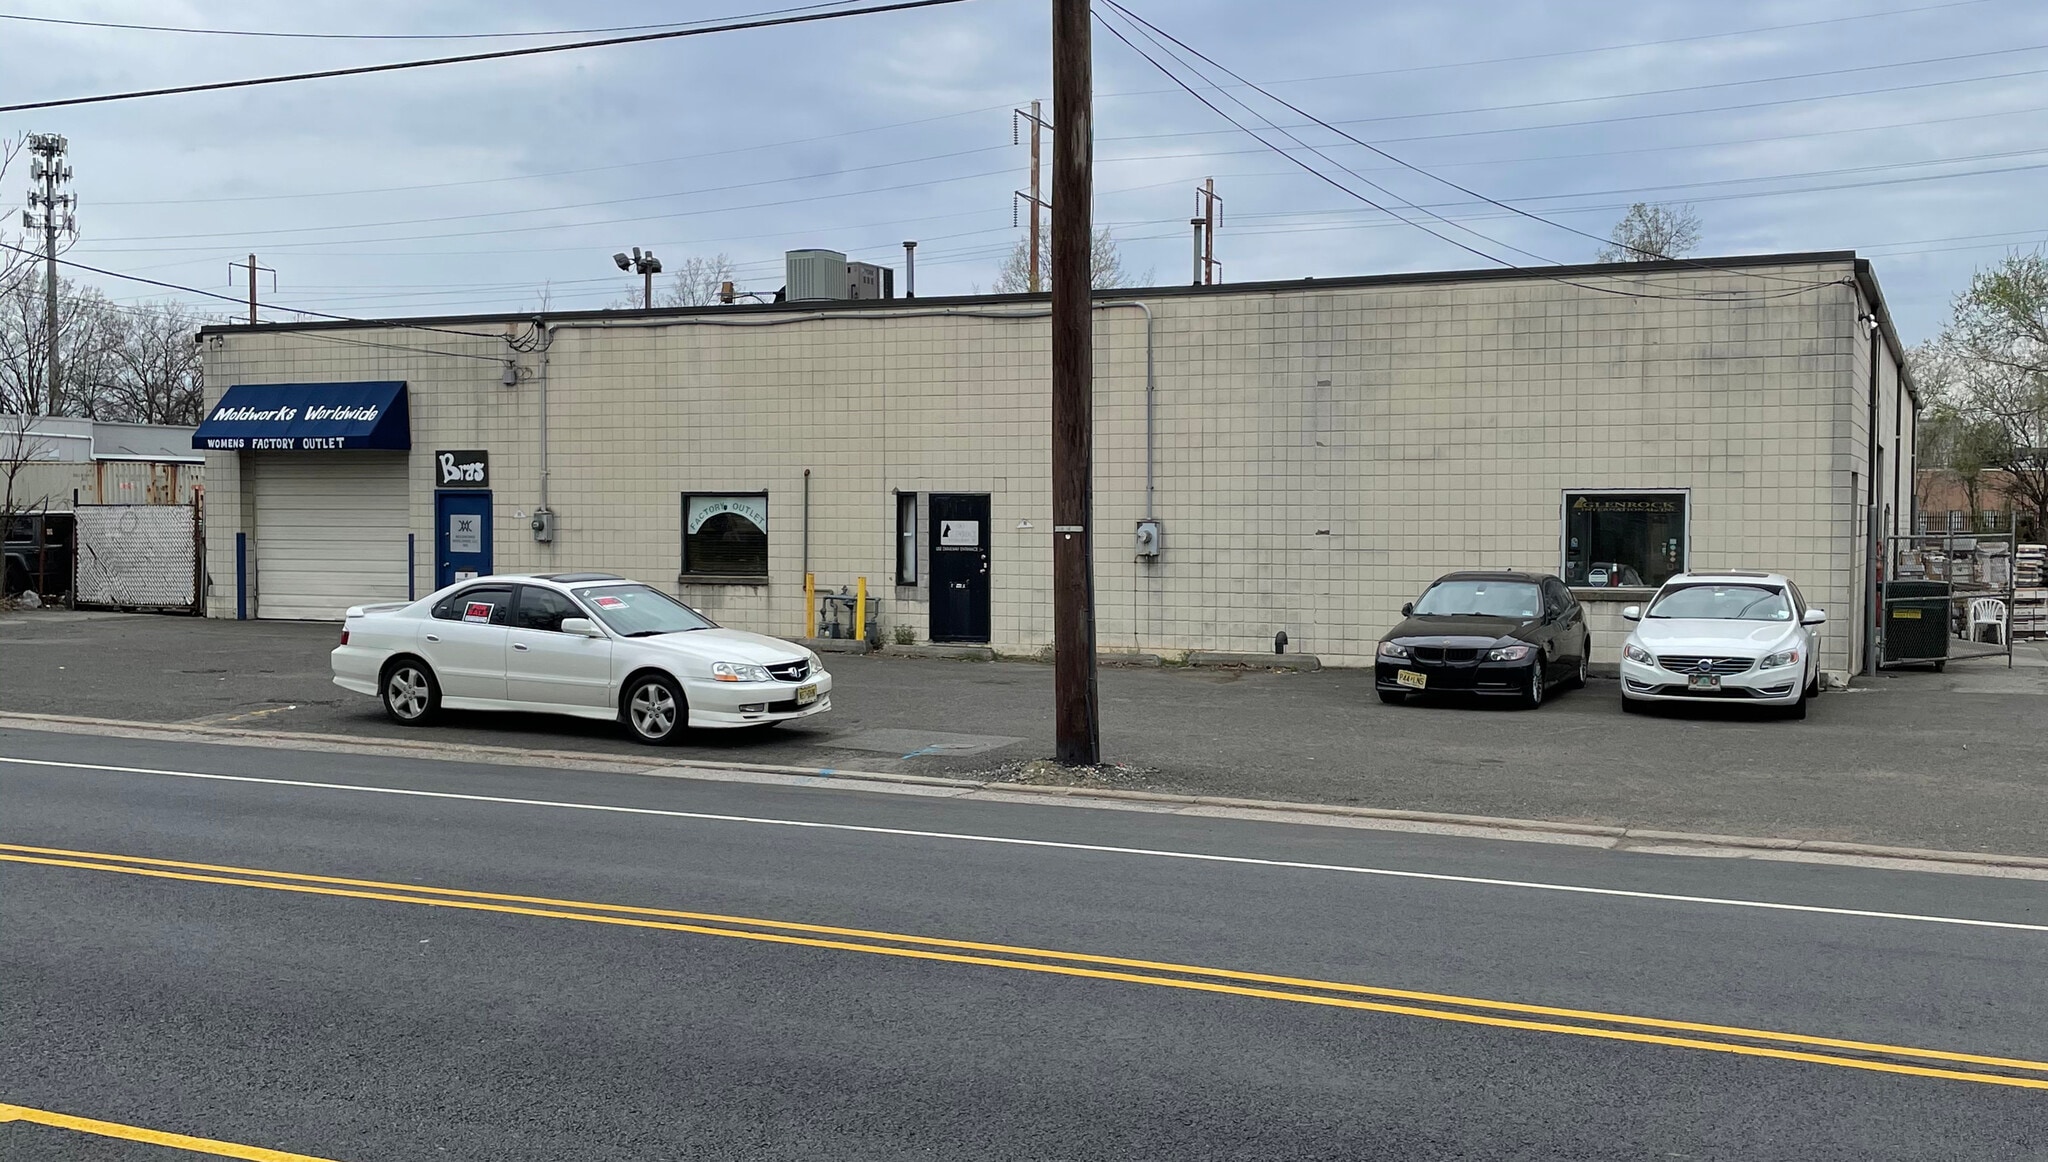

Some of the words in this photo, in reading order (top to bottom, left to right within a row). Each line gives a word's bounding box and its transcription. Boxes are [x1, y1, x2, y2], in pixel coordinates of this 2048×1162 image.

[304, 404, 379, 421] Worldwide
[207, 438, 245, 449] WOMENS
[252, 438, 295, 449] FACTORY
[302, 437, 345, 449] OUTLET
[439, 453, 485, 483] Bras
[690, 502, 725, 530] FACTORY
[732, 502, 765, 525] OUTLET
